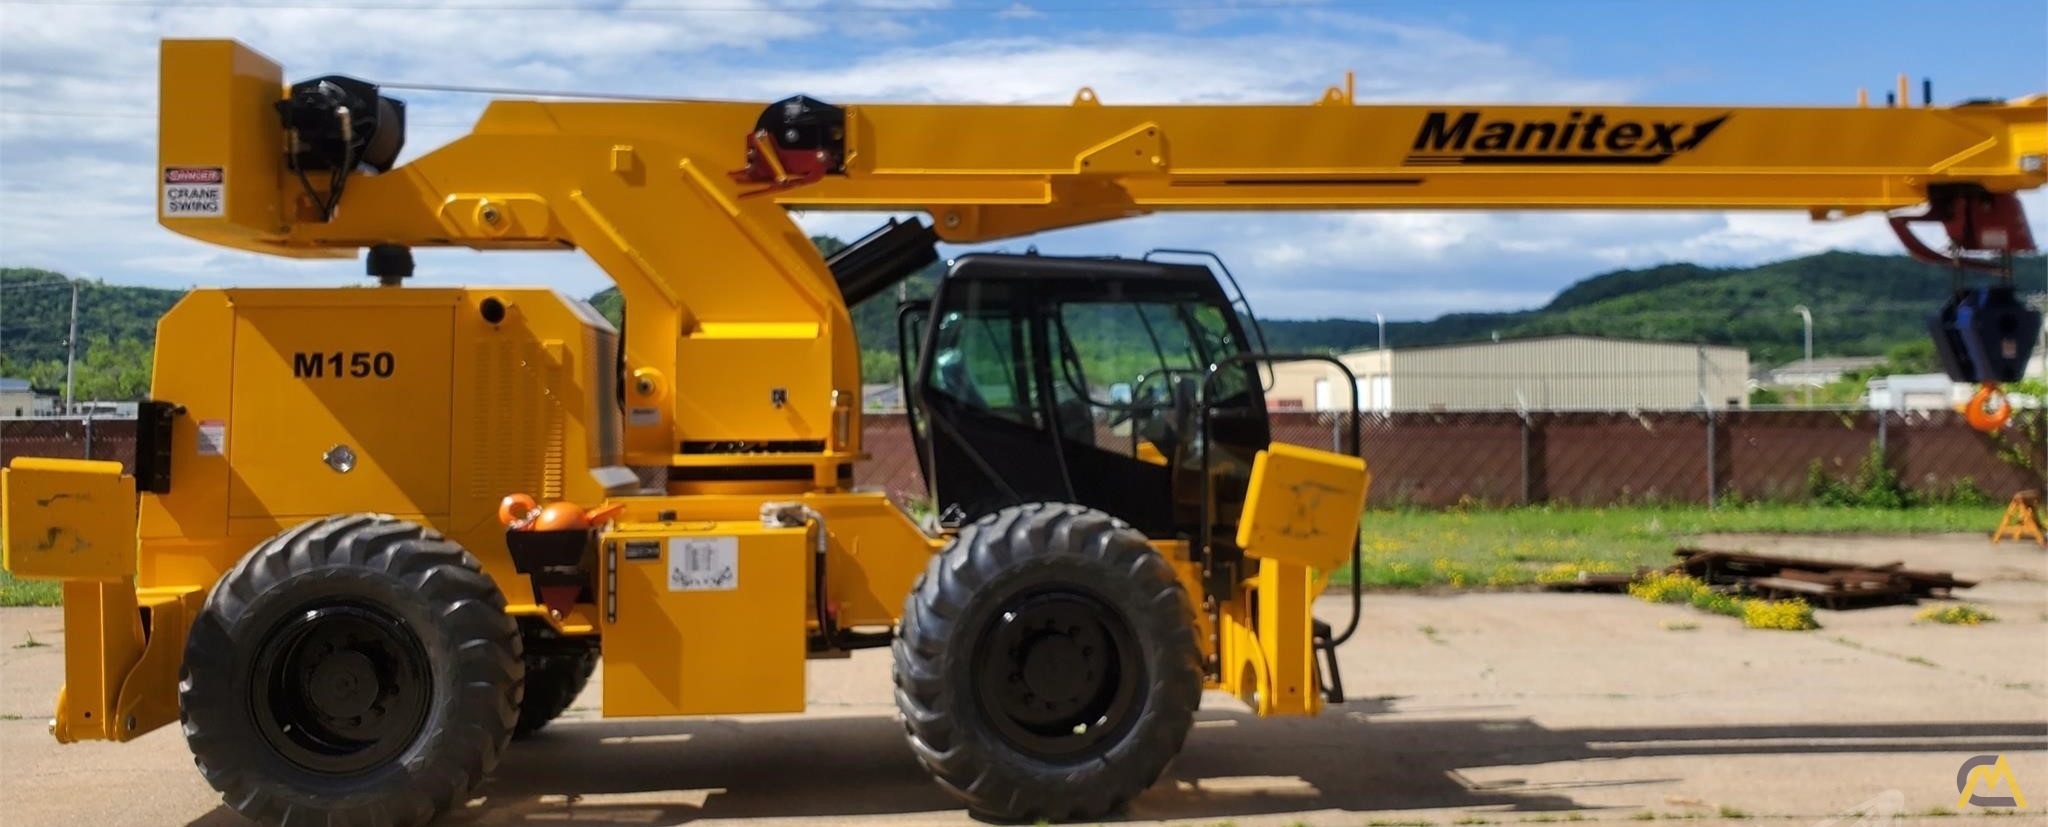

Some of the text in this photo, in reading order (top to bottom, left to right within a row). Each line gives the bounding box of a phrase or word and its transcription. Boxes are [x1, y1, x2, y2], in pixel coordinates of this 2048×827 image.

[1412, 110, 1684, 153] Manitex
[167, 188, 218, 199] CRANE
[169, 202, 218, 212] SWING
[294, 351, 395, 378] M150
